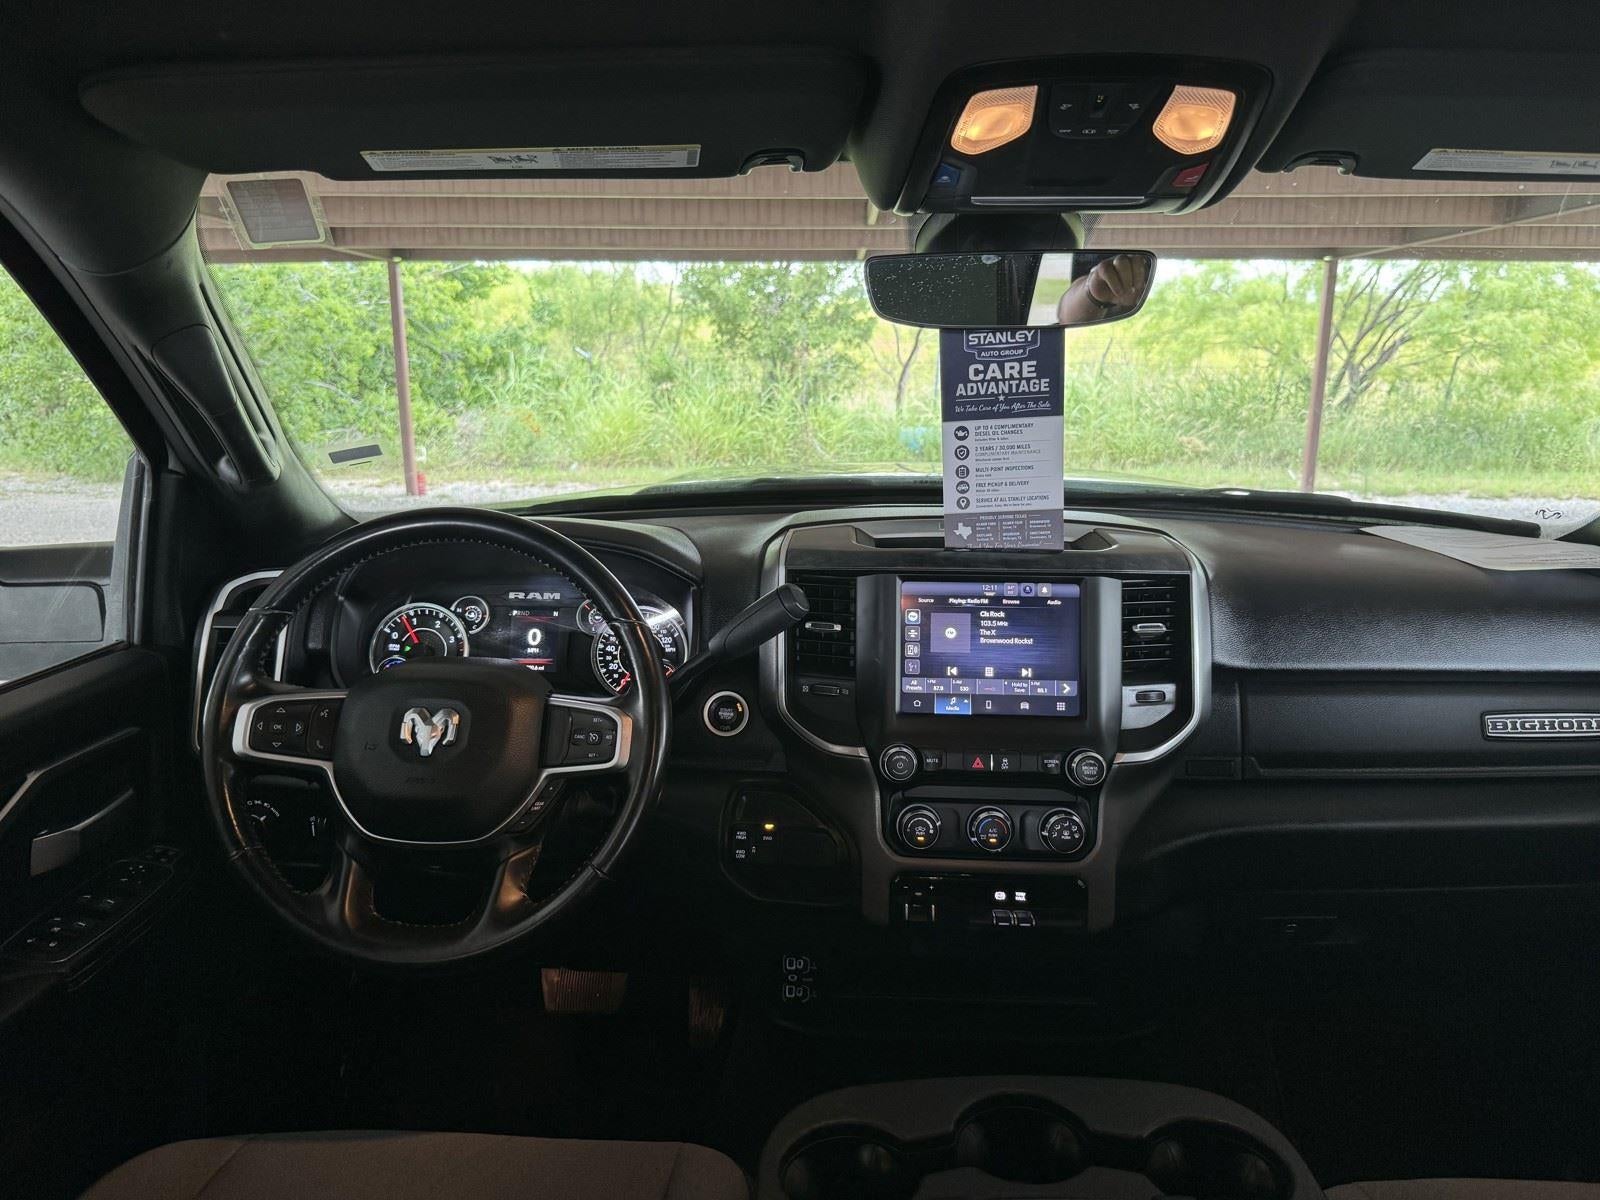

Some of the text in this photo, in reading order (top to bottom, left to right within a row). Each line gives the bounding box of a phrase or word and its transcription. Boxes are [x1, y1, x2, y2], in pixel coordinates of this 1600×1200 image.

[968, 329, 1035, 345] STANLEY
[968, 361, 1037, 381] CARE
[955, 378, 1050, 396] ADVANTAGE
[955, 405, 964, 413] We
[965, 404, 978, 412] Take
[978, 403, 991, 411] Care
[992, 403, 999, 412] of
[999, 402, 1010, 412] You
[1011, 402, 1026, 411] After
[508, 591, 561, 600] RAM
[435, 620, 441, 628] 2
[391, 631, 399, 639] 0
[527, 628, 542, 646] 0
